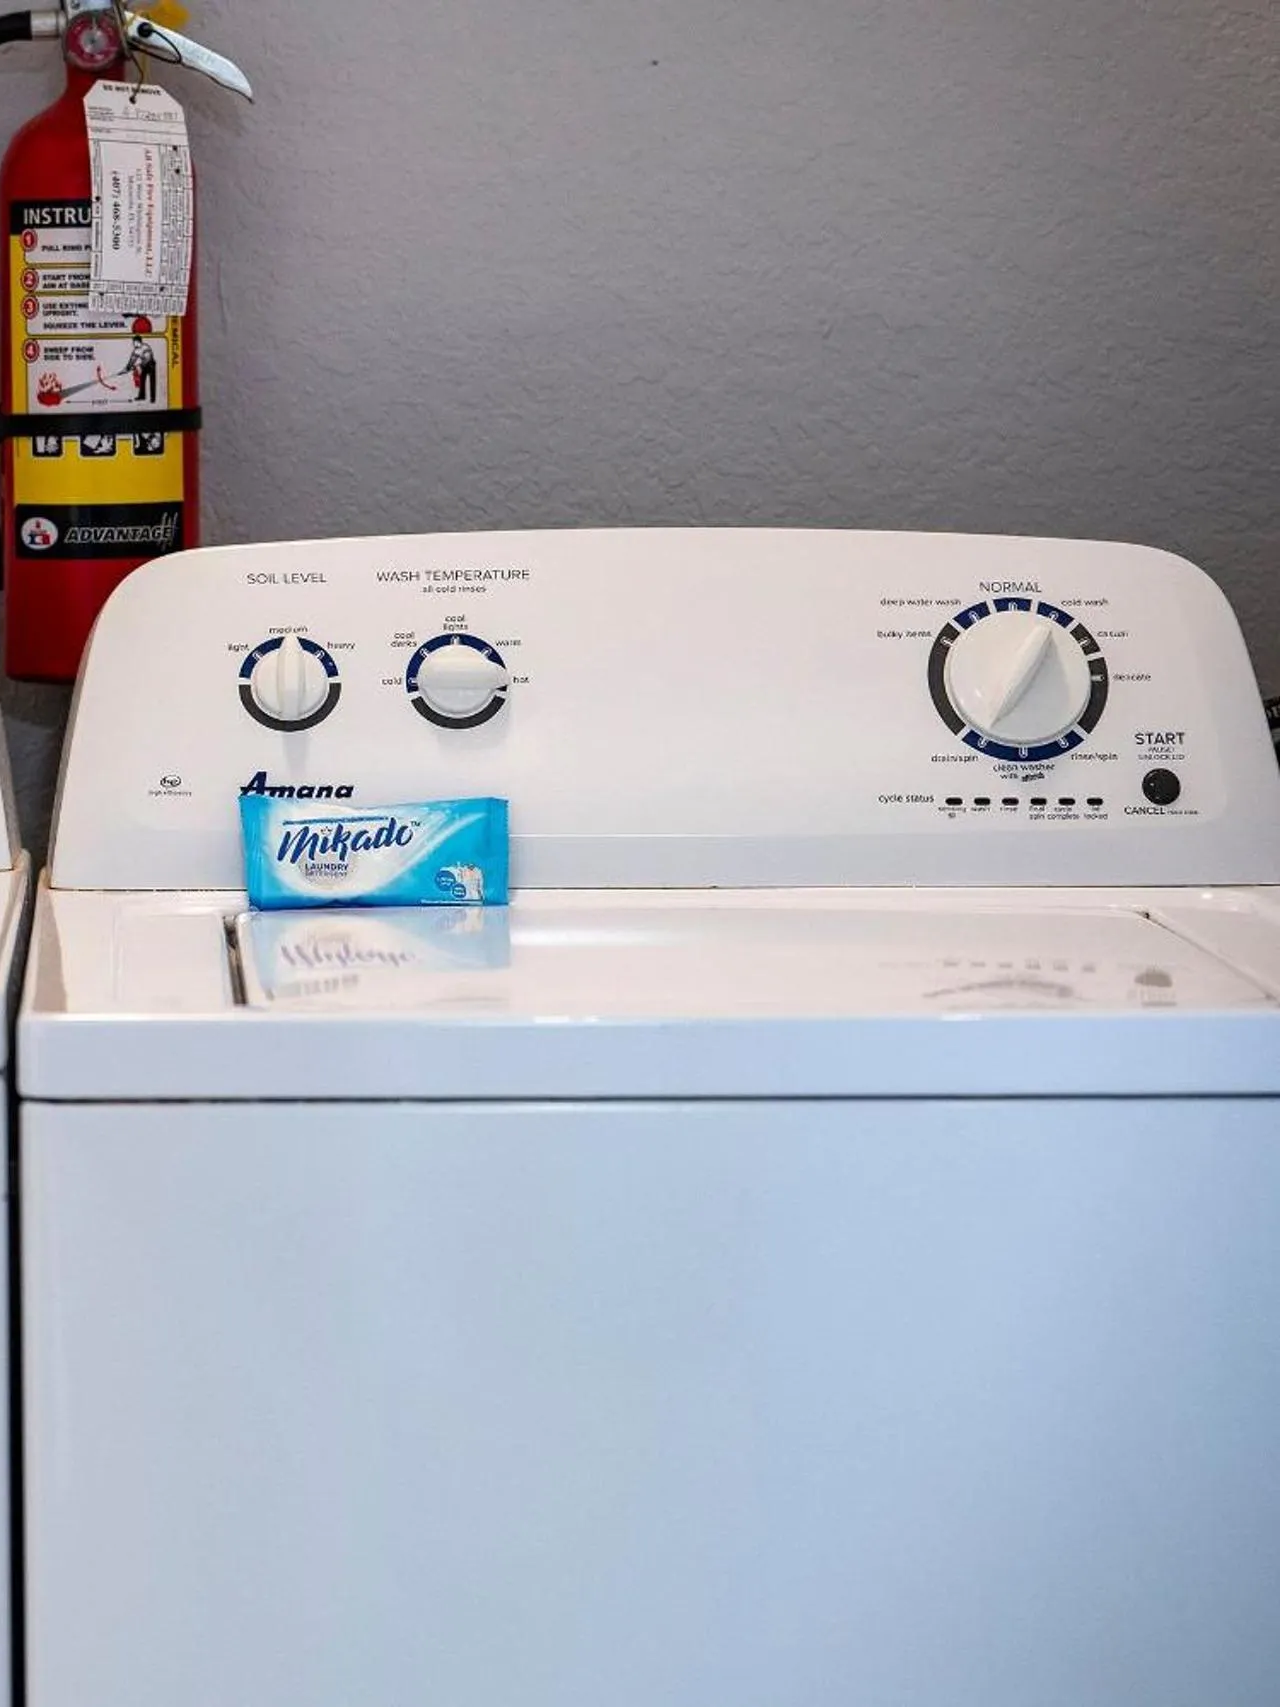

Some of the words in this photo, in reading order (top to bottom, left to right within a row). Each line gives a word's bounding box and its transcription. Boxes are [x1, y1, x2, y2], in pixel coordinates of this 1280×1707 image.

[64, 525, 171, 544] ADVANTAGE
[246, 573, 280, 585] SOIL
[283, 572, 327, 584] LEVEL
[376, 571, 420, 582] WASH
[425, 569, 531, 582] TEMPERATURE
[435, 585, 456, 593] cold
[458, 585, 487, 593] rinses
[979, 581, 1042, 593] NORMAL
[880, 598, 906, 606] deep
[1061, 599, 1082, 607] cold
[1084, 597, 1109, 606] wash
[444, 614, 466, 622] cool
[443, 623, 469, 632] lights
[394, 632, 415, 640] cool
[390, 639, 418, 648] darks
[381, 676, 403, 685] cold
[513, 676, 530, 684] hot
[1134, 732, 1186, 745] START
[993, 764, 1019, 773] clean
[1020, 763, 1056, 771] washer
[240, 771, 355, 799] Amana
[878, 794, 904, 804] cycle
[906, 794, 935, 804] status
[1124, 806, 1166, 815] CANCEL
[277, 817, 414, 865] Mikado
[305, 863, 349, 871] LAUNDRY
